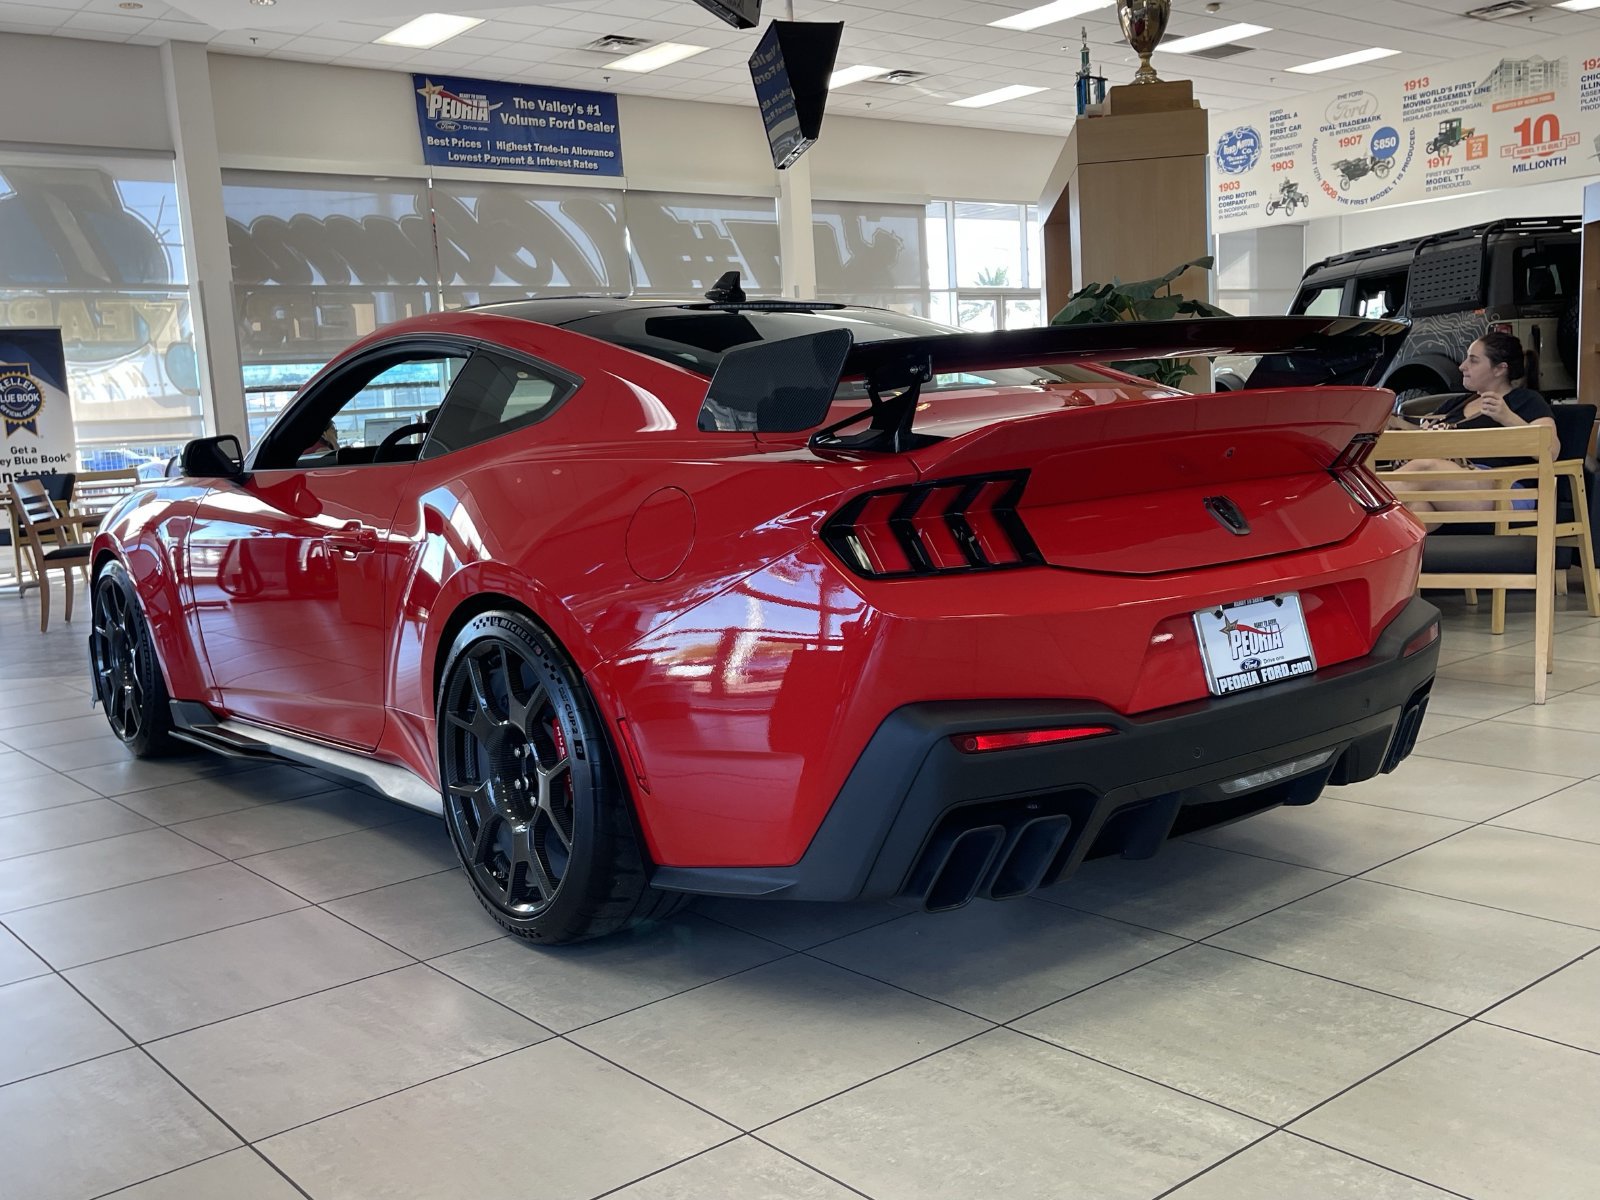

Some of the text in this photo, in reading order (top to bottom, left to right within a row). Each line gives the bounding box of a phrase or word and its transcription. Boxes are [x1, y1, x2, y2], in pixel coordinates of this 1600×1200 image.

[1403, 81, 1477, 102] THE WORLD'S FIRST
[1404, 77, 1430, 92] 1913
[1348, 90, 1363, 98] FORD
[1403, 86, 1492, 109] MOVING ASSEMBLY LINE
[428, 94, 491, 122] PEORIA
[513, 97, 601, 116] The Valley's #1
[1333, 98, 1369, 120] Ford
[1403, 106, 1425, 116] BEGINS
[1425, 100, 1459, 111] OPERATION
[500, 112, 615, 133] Volume Ford Dealer
[1270, 114, 1291, 122] MODEL
[1320, 114, 1382, 132] OVAL TRADEMARK
[1403, 113, 1433, 123] HIGHLAND
[1270, 124, 1302, 135] FIRST CAR
[1270, 132, 1298, 141] PRODUCED
[1514, 113, 1560, 160] 10
[427, 135, 615, 158] Best Prices Highest Trade-In Allowance
[1338, 134, 1363, 148] 1907
[1373, 136, 1396, 151] $850
[448, 152, 599, 170] Lowest Payment & Interest Rates
[1271, 159, 1294, 172] 1903
[1427, 155, 1452, 169] 1917
[1512, 156, 1567, 174] MILLIONTH
[1311, 137, 1319, 165] AUGUST
[1320, 180, 1338, 199] 1908
[1337, 195, 1349, 205] THE
[1350, 198, 1368, 206] FIRST
[1370, 186, 1393, 202] MODEL
[1397, 173, 1404, 181] IS
[1218, 180, 1240, 192] 1903
[1426, 176, 1452, 186] MODEL
[1218, 190, 1257, 201] FORD MOTOR
[1218, 199, 1247, 208] COMPANY
[16, 393, 40, 402] BOOK
[10, 446, 29, 455] Get
[14, 456, 39, 465] Blue
[499, 618, 543, 656] MICHELI
[1230, 623, 1284, 661] PEORIA
[1243, 659, 1259, 670] Ford
[1263, 657, 1275, 665] Drive
[1219, 660, 1313, 693] PEORIA FORD.com
